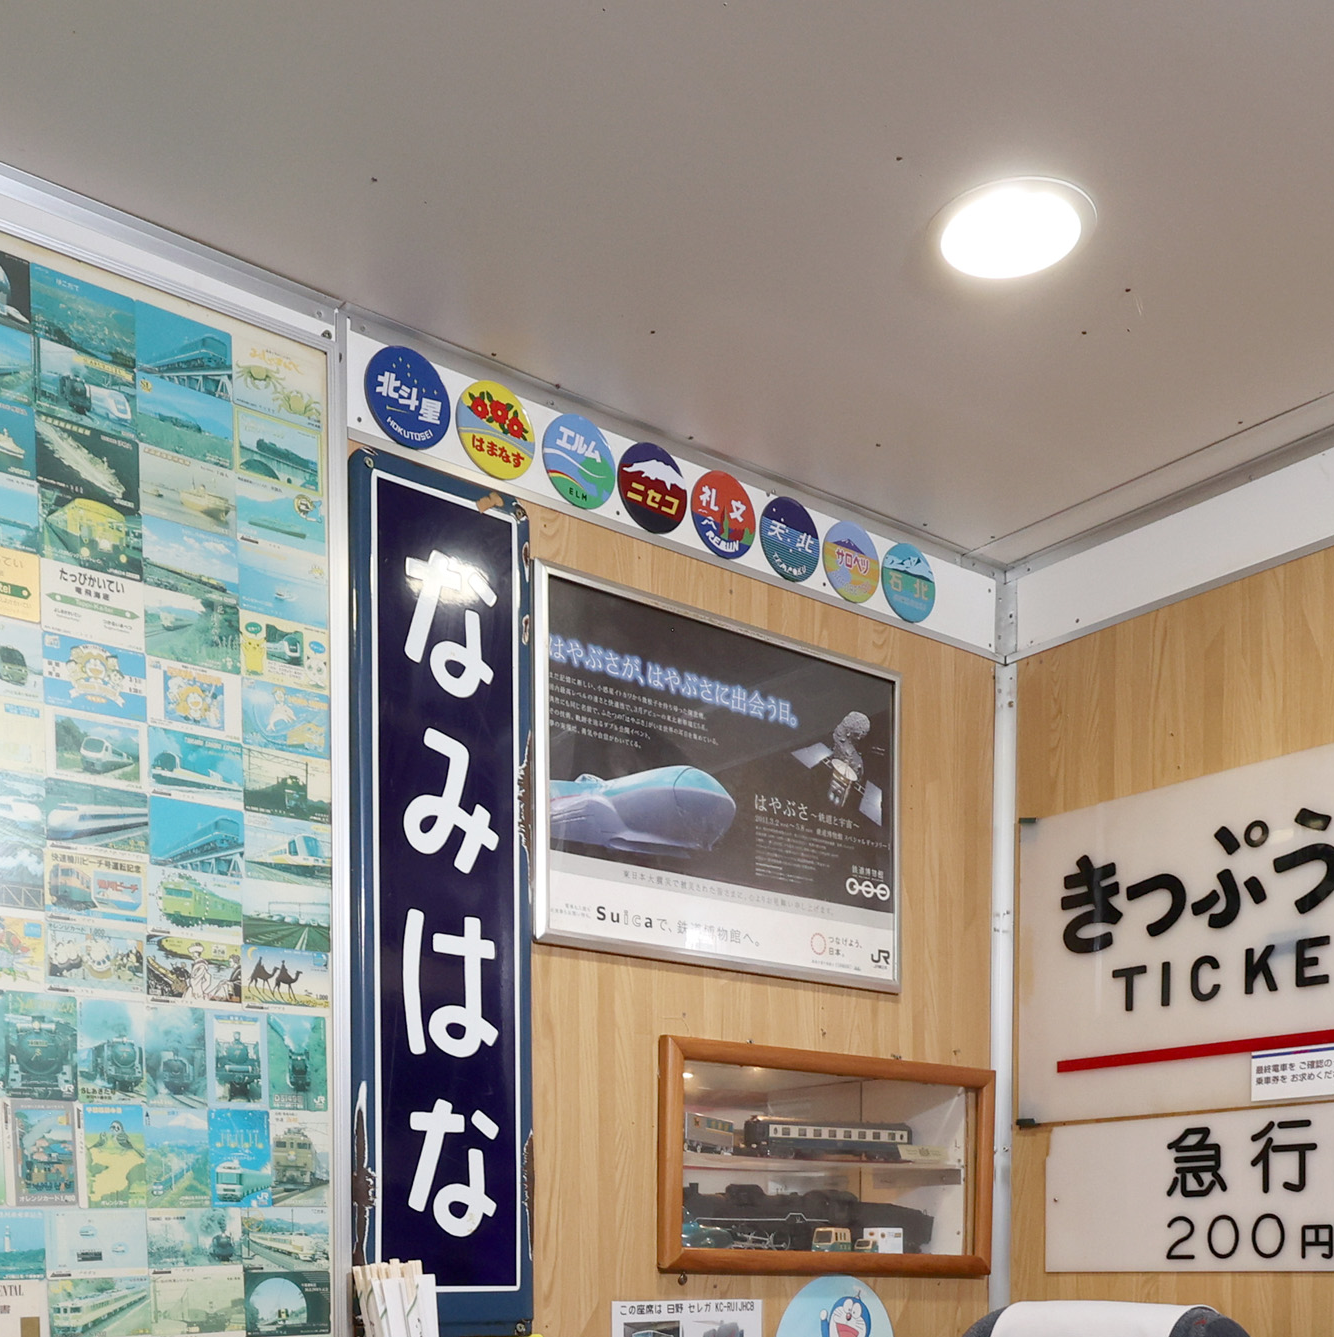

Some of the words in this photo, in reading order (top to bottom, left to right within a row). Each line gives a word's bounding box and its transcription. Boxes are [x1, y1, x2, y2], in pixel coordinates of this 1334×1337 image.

[375, 371, 442, 425] 北斗星
[386, 416, 434, 442] HOKUTOSEI
[472, 434, 525, 468] はまなす
[556, 425, 602, 463] エルム
[568, 487, 588, 502] ELM
[627, 482, 680, 516] ニセコ
[699, 485, 747, 523] 礼文
[705, 530, 740, 554] REBUN
[768, 520, 815, 554] 天北
[835, 548, 870, 575] サロベツ
[59, 567, 125, 595] たっぴかいてい
[889, 571, 929, 601] 石北
[549, 638, 798, 727] はやぶさが、はやぶさに出会う日。
[402, 549, 499, 1238] なみはな
[827, 934, 863, 949] つなげよう、
[827, 945, 846, 958] 日本。
[871, 949, 890, 965] JR
[1255, 1062, 1296, 1075] 最終電車を
[1255, 1075, 1288, 1086] 乗車券を
[620, 1304, 663, 1316] この座席は
[666, 1303, 684, 1315] 日野
[688, 1302, 712, 1314] セレガ
